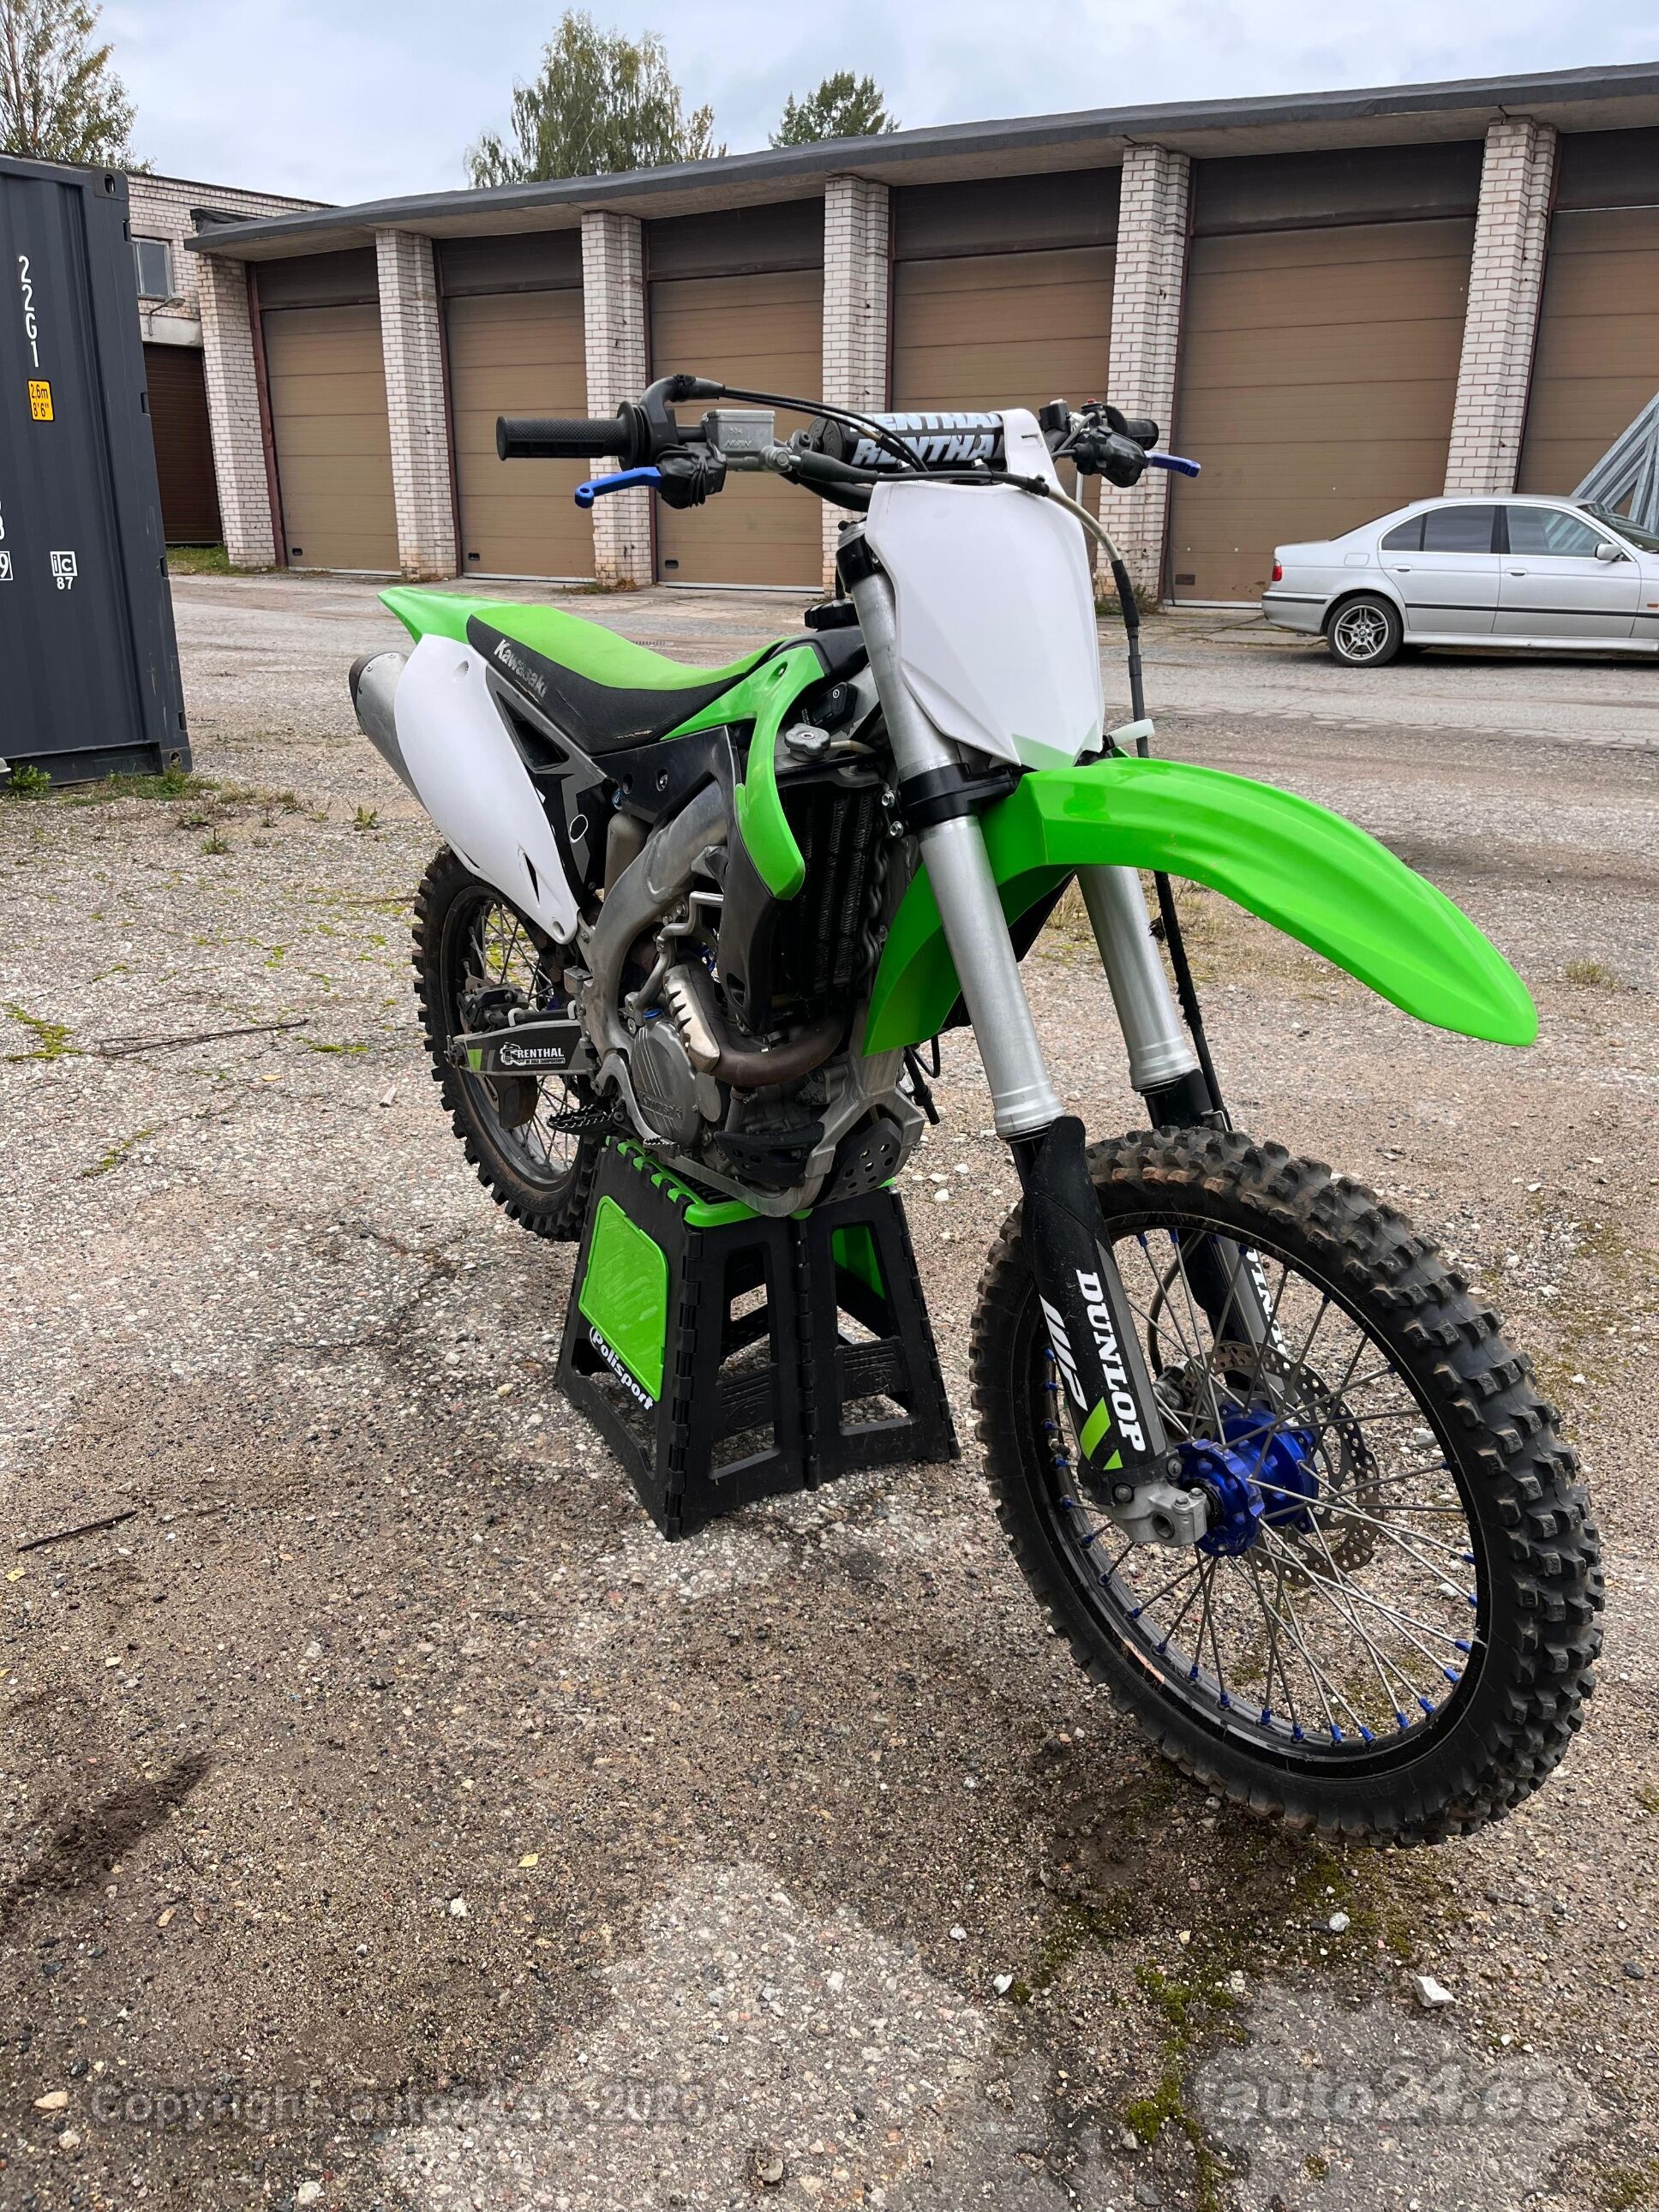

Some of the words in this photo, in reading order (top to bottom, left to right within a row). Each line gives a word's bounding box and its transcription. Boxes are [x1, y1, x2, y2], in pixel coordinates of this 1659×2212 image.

[18, 255, 39, 368] 22G1
[56, 576, 74, 590] 87
[494, 638, 548, 698] Kawasaki
[517, 1047, 565, 1058] RENTHAL
[591, 1328, 654, 1411] Polisport
[1075, 1268, 1147, 1452] DUNLOP
